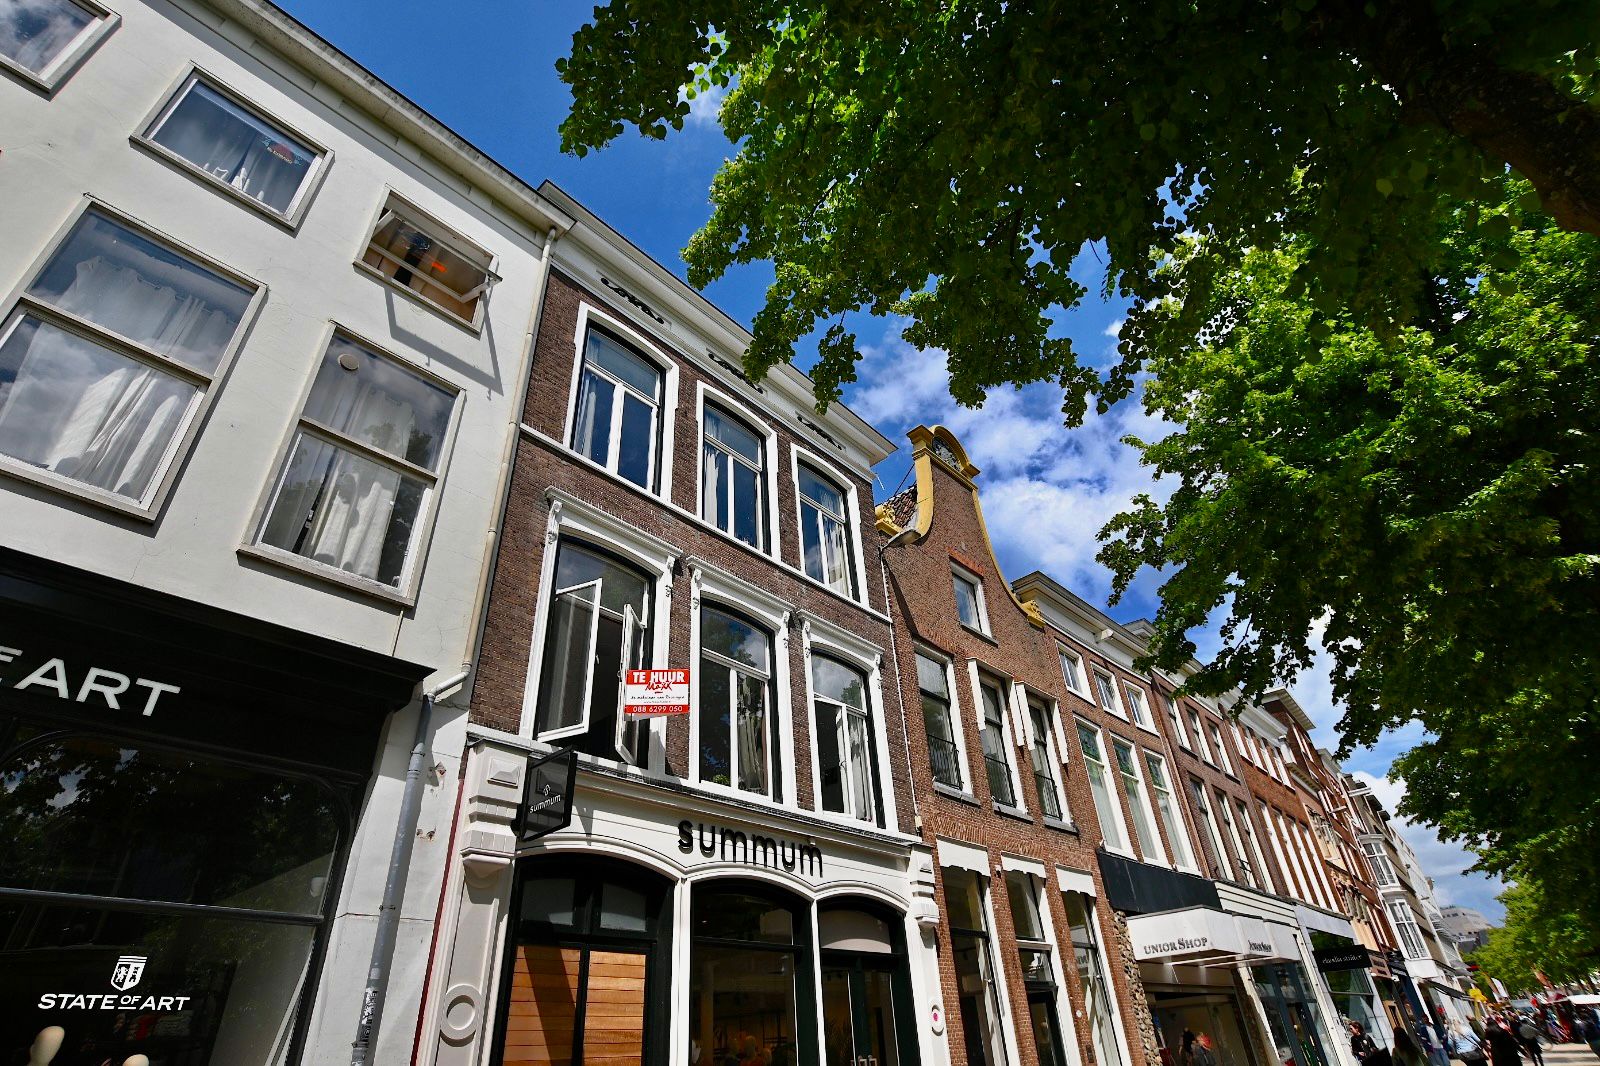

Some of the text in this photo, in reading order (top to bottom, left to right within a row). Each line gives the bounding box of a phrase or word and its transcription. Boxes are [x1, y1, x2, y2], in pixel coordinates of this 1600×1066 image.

[633, 671, 685, 684] TE HUUR
[13, 657, 181, 717] ART
[649, 705, 667, 713] 6299
[669, 705, 683, 713] 050
[529, 794, 561, 813] summum
[678, 820, 823, 878] summum
[37, 993, 191, 1011] STATE OF ART
